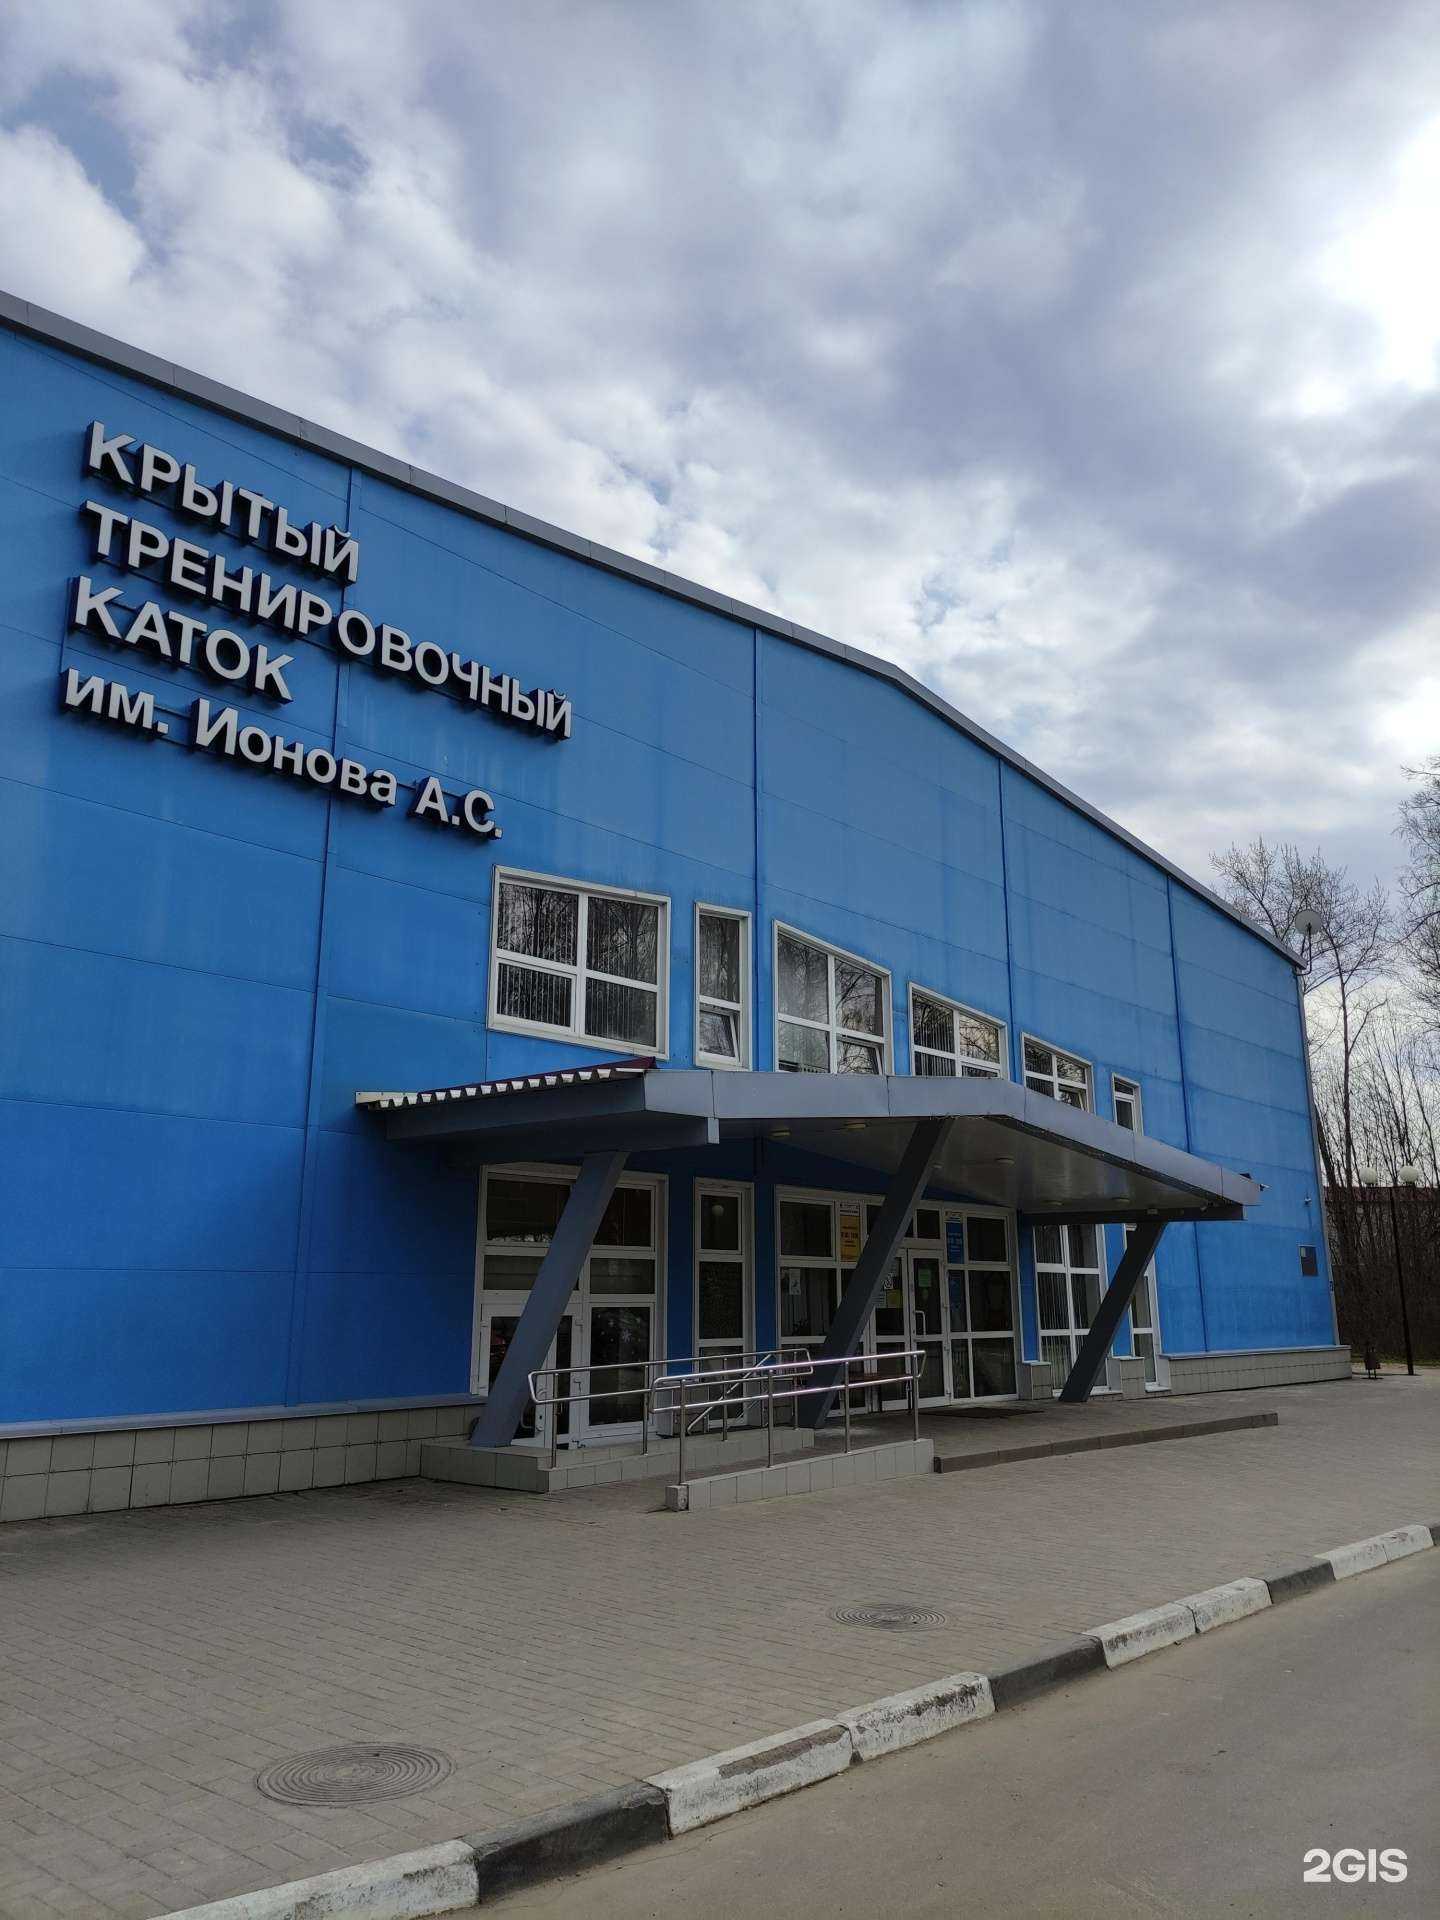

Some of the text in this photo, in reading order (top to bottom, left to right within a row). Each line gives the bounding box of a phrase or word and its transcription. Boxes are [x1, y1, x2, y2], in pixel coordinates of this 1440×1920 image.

[87, 421, 360, 584] КРЫТЫЙ
[73, 576, 295, 702] КАТОК
[83, 500, 573, 739] ТРЕНИРОВОЧНЫЙ
[64, 668, 504, 839] им. Ионова А.С.
